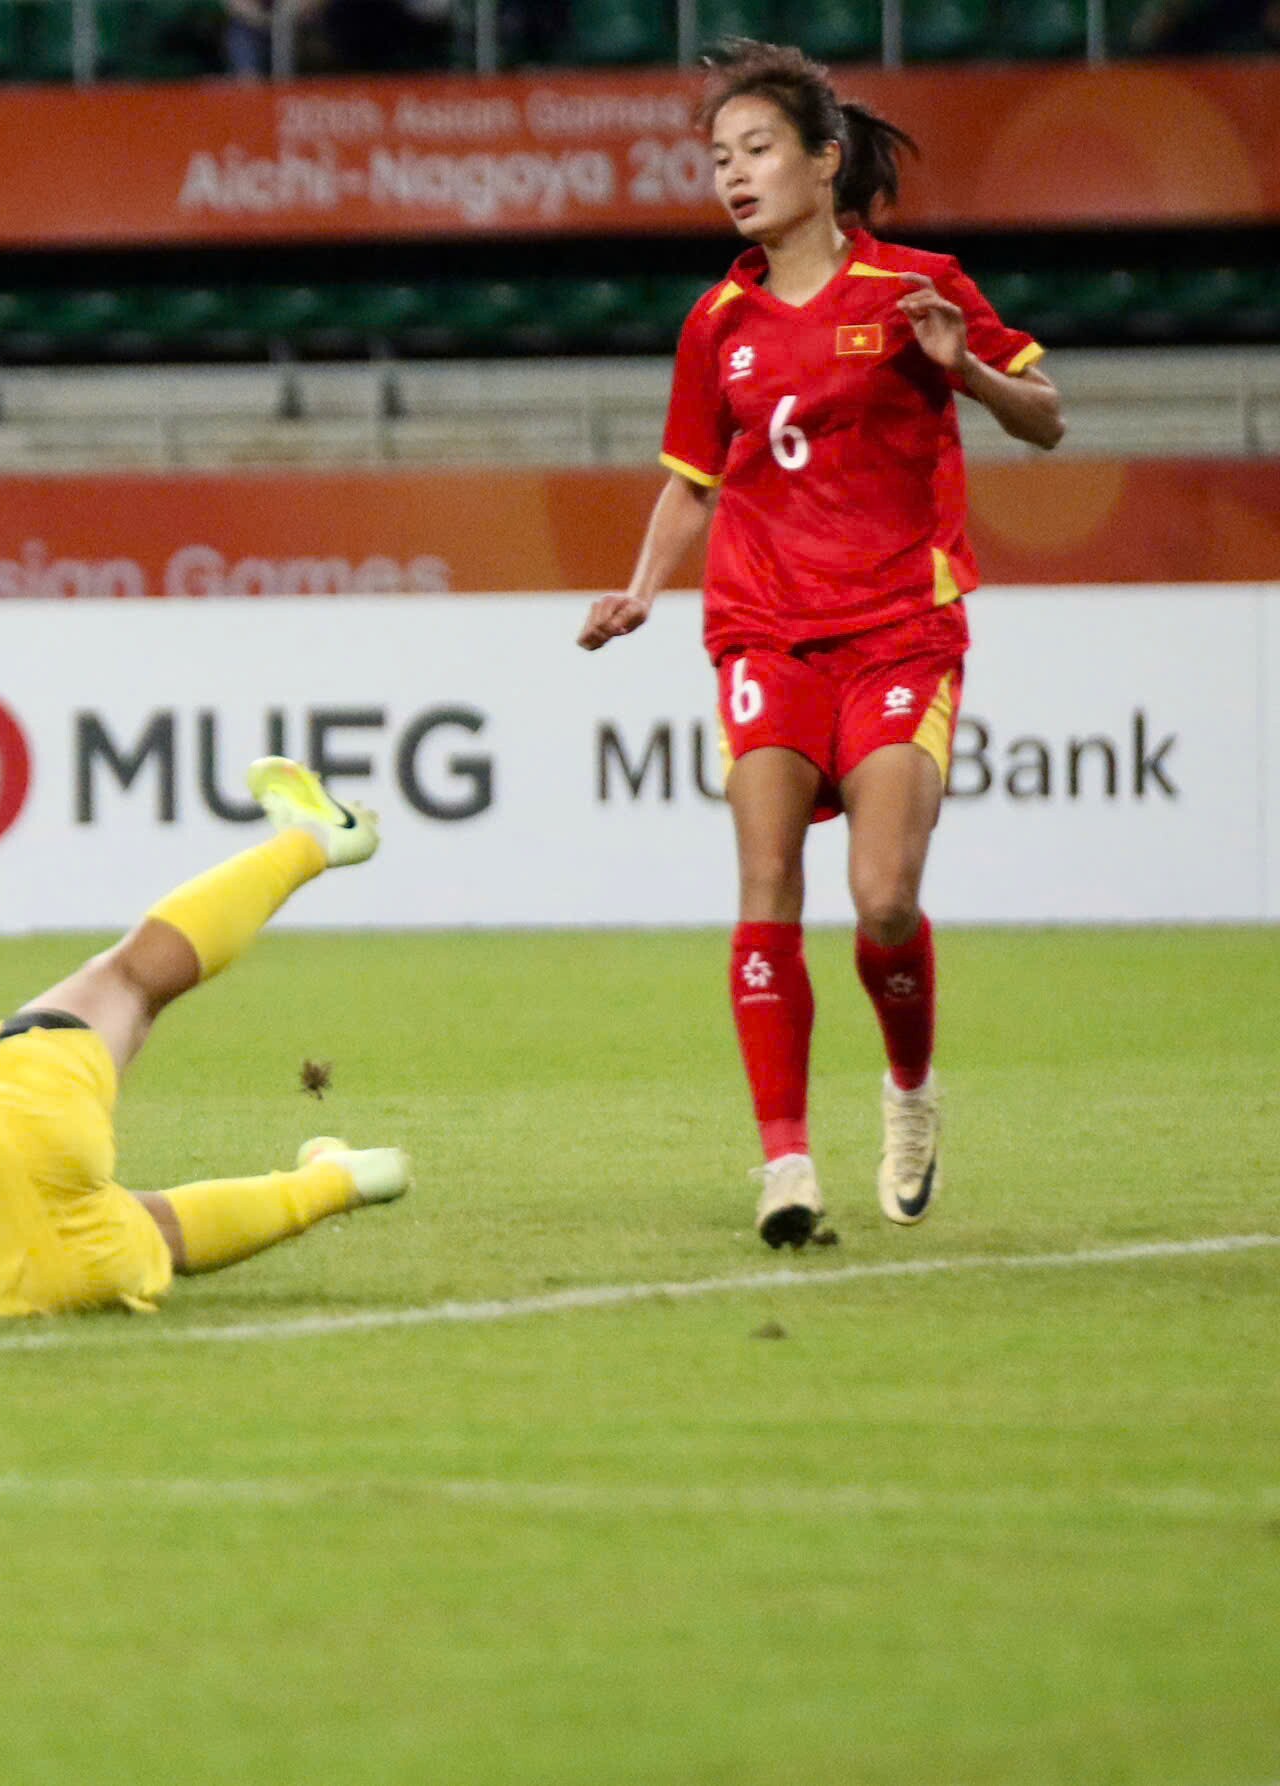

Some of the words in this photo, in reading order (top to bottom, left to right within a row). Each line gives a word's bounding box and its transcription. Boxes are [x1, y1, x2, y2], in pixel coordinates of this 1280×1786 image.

[178, 140, 614, 224] Aichi-Nagoya
[770, 395, 811, 470] 6
[165, 544, 453, 597] Games
[731, 658, 762, 723] 6
[73, 705, 494, 825] MUFG
[945, 707, 1179, 802] Bank
